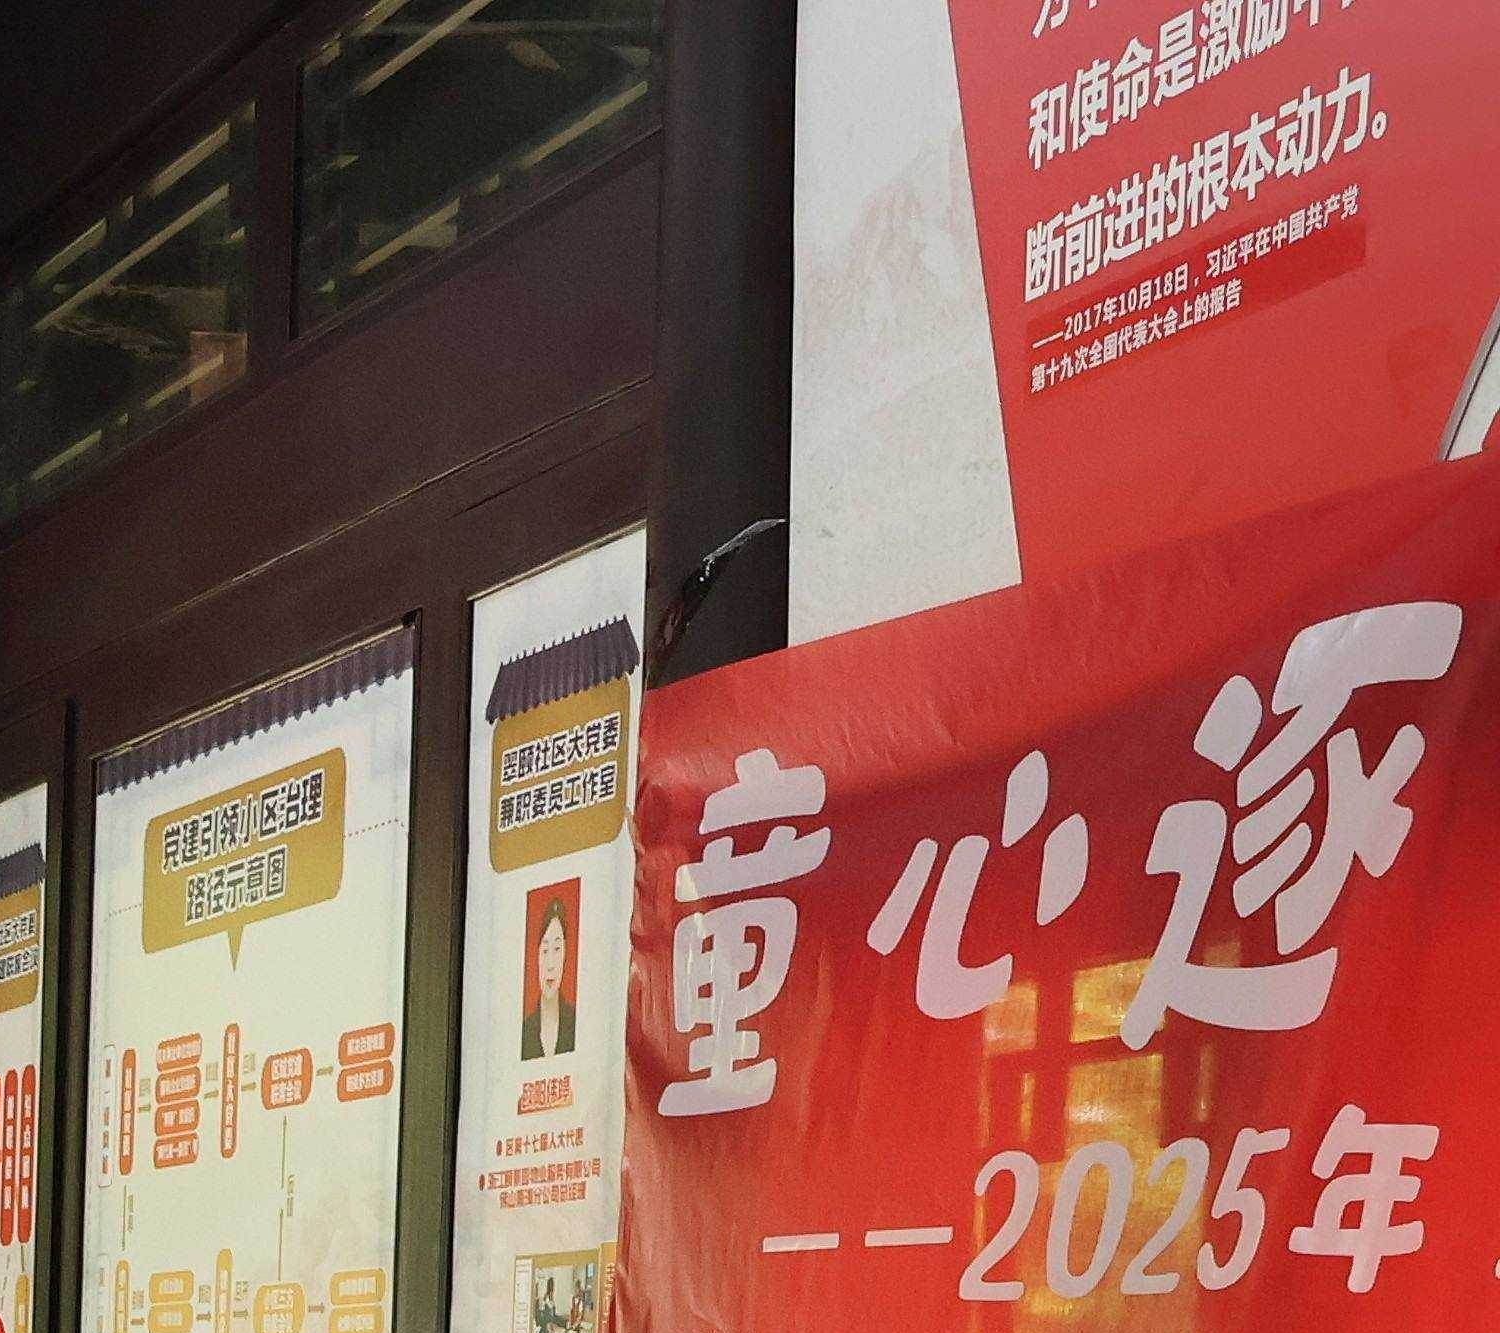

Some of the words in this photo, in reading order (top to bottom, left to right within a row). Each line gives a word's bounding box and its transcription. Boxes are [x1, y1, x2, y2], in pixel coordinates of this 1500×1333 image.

[1024, 67, 1387, 302] 断前进的根本动力。
[1030, 277, 1243, 393] 第十九次全国代表大会上的报告
[499, 763, 616, 830] 兼职委员工作室
[501, 715, 619, 783] 翠颐社区大党委
[163, 771, 323, 870] 党建引领小区治理
[657, 600, 1464, 1118] 童心逐
[186, 847, 287, 921] 路径示意图
